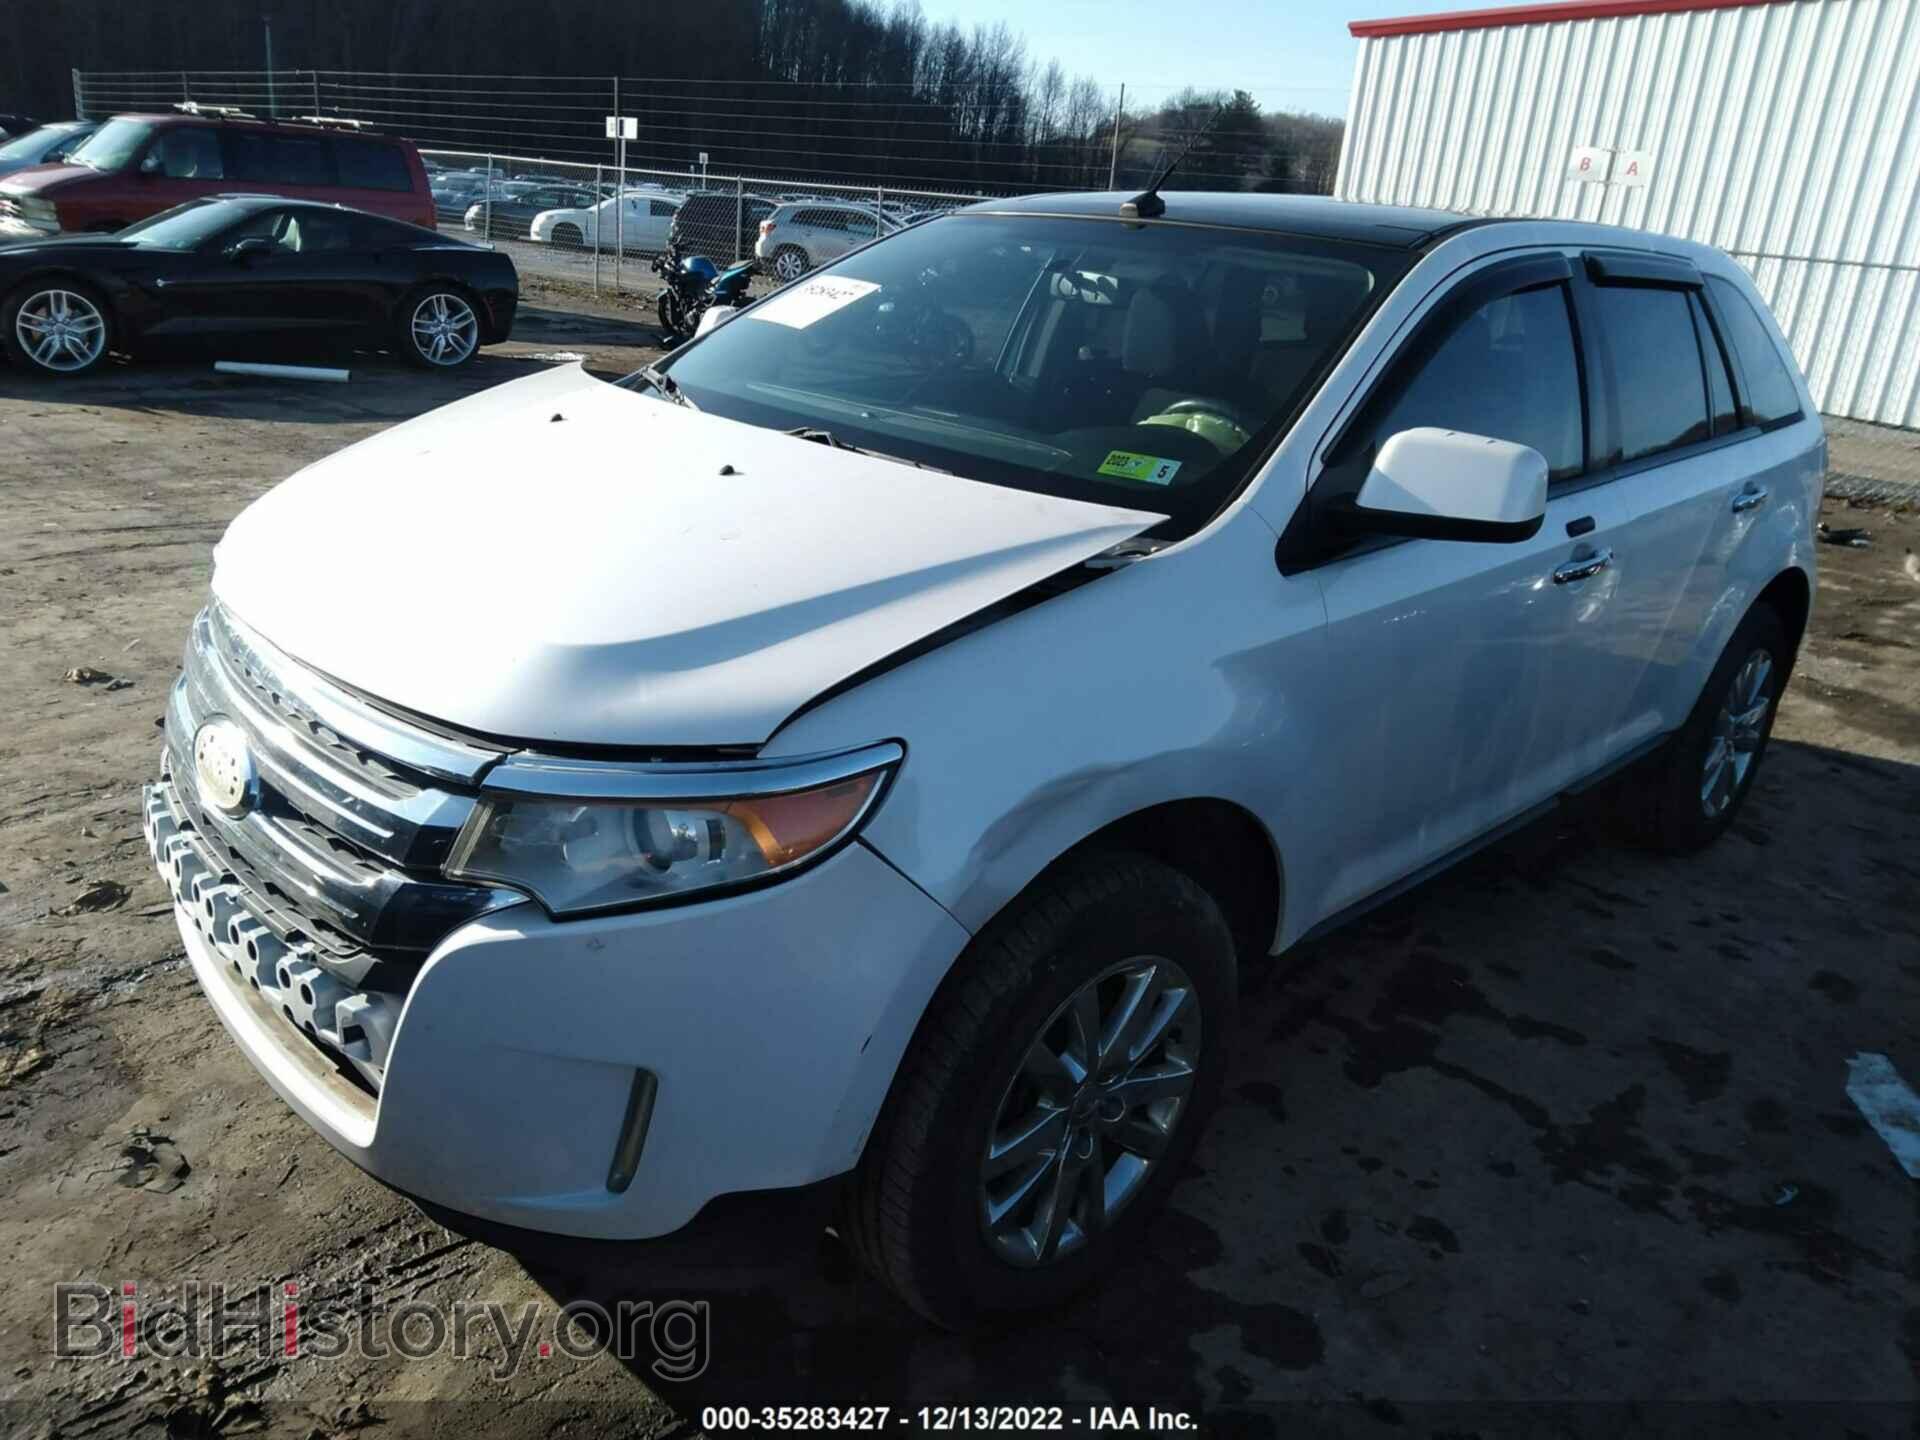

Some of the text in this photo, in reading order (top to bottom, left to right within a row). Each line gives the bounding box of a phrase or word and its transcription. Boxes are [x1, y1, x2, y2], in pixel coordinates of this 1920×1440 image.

[1580, 157, 1592, 172] B
[1625, 160, 1639, 176] A
[1157, 464, 1170, 479] 5
